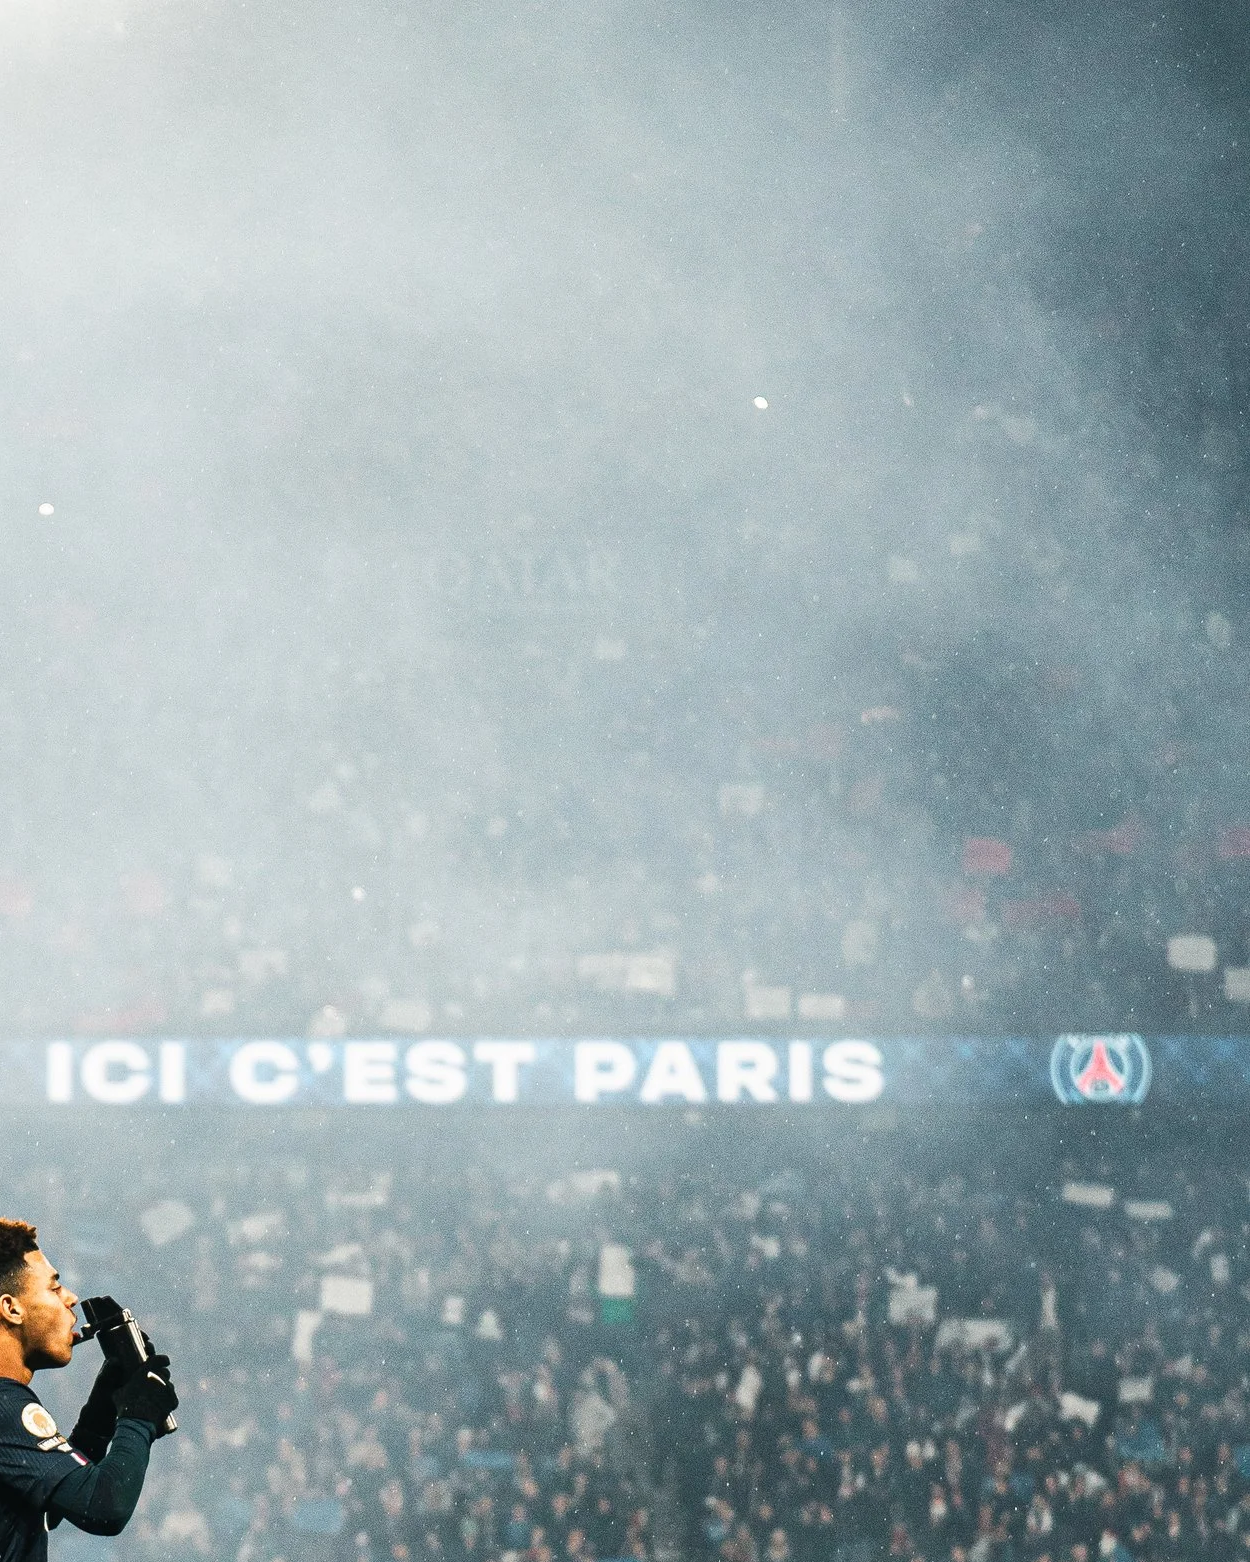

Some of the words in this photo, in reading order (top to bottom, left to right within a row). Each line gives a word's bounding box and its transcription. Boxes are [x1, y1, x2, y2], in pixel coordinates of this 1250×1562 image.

[45, 1039, 187, 1105] ICI
[228, 1039, 542, 1105] C'EST
[573, 1039, 885, 1104] PARIS
